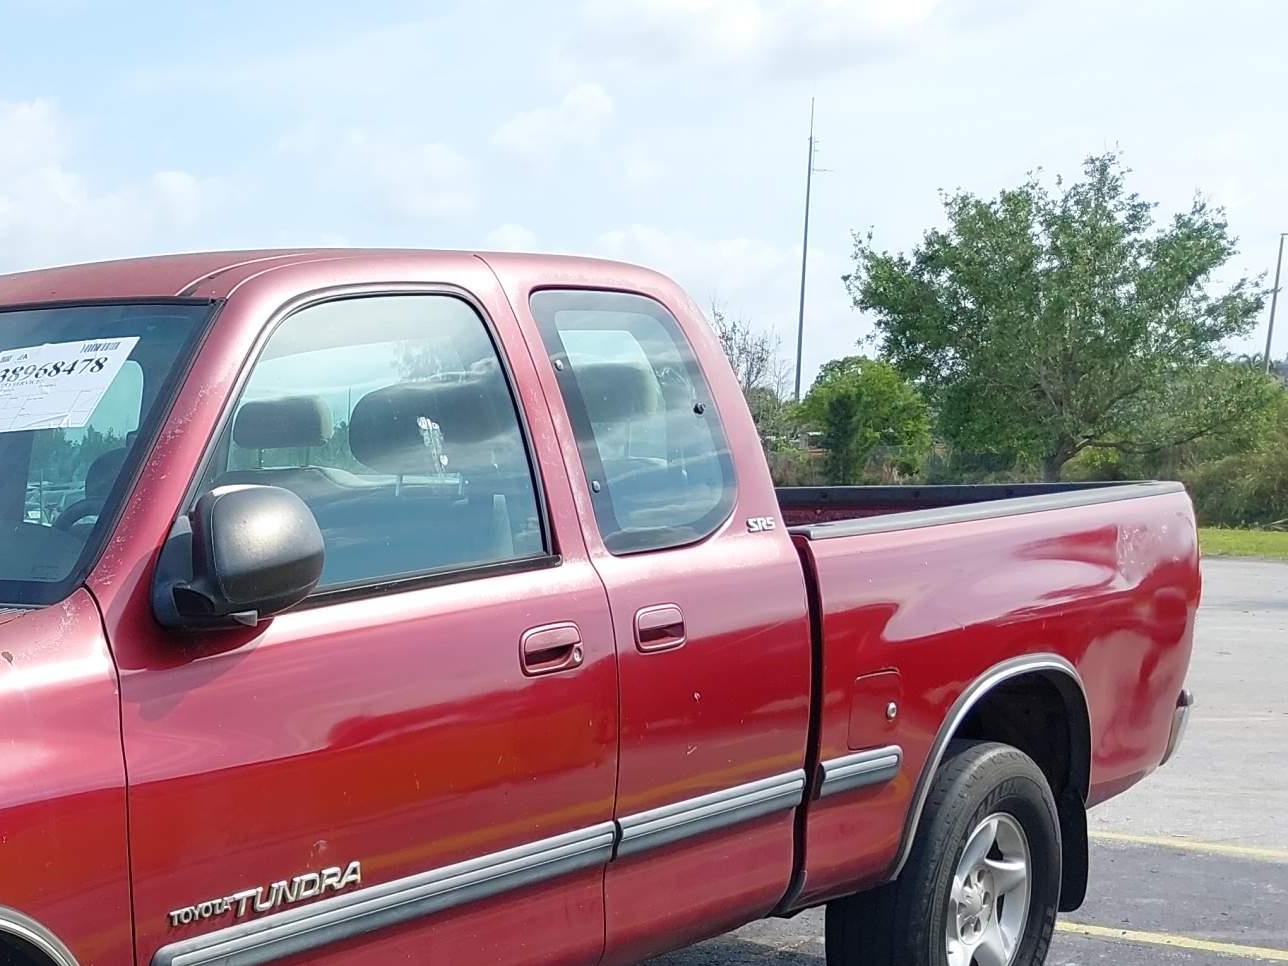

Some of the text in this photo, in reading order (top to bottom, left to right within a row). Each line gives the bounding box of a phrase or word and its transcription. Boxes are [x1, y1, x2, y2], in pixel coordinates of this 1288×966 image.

[745, 516, 776, 533] SR5
[169, 860, 362, 927] TOYOTA TUNDRA
